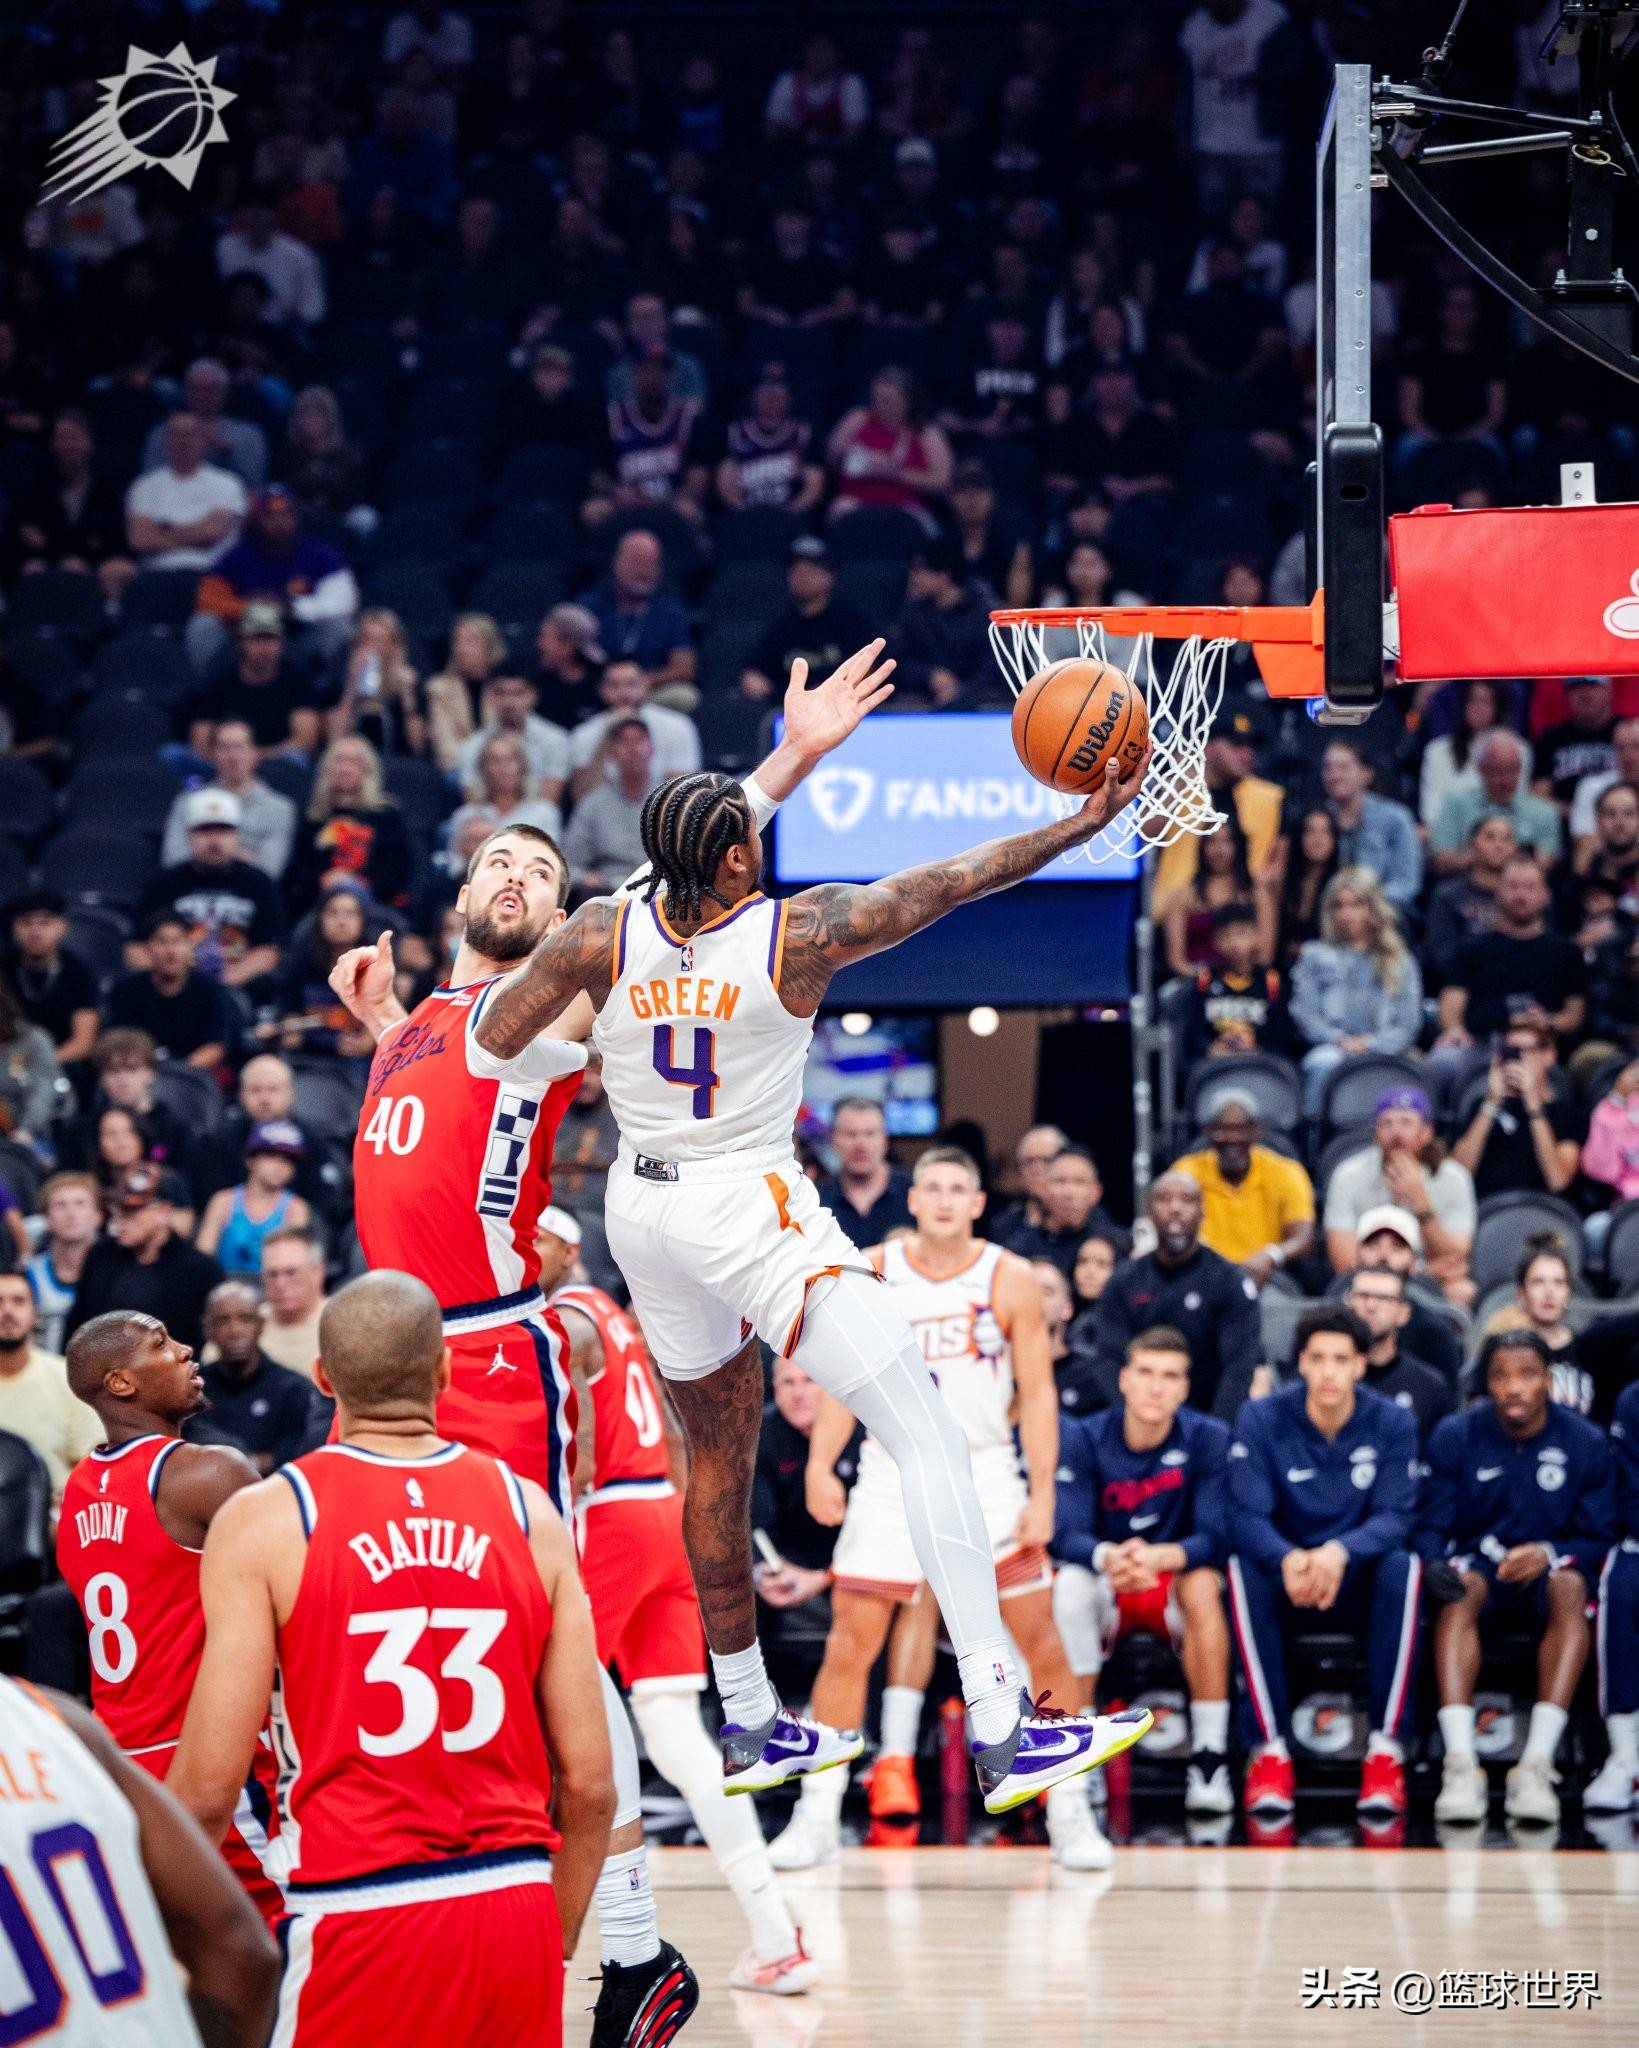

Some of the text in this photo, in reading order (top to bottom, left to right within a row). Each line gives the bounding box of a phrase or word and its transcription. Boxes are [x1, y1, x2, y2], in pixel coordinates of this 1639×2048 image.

[1067, 691, 1124, 772] Wilson
[629, 977, 741, 1021] GREEN
[653, 1023, 720, 1120] 4
[363, 1094, 425, 1156] 40
[625, 1361, 662, 1448] 0
[75, 1501, 128, 1549] DUNN
[348, 1517, 491, 1584] BATUM
[84, 1572, 138, 1684] 8
[347, 1606, 508, 1758] 33
[1292, 1691, 1354, 1753] G
